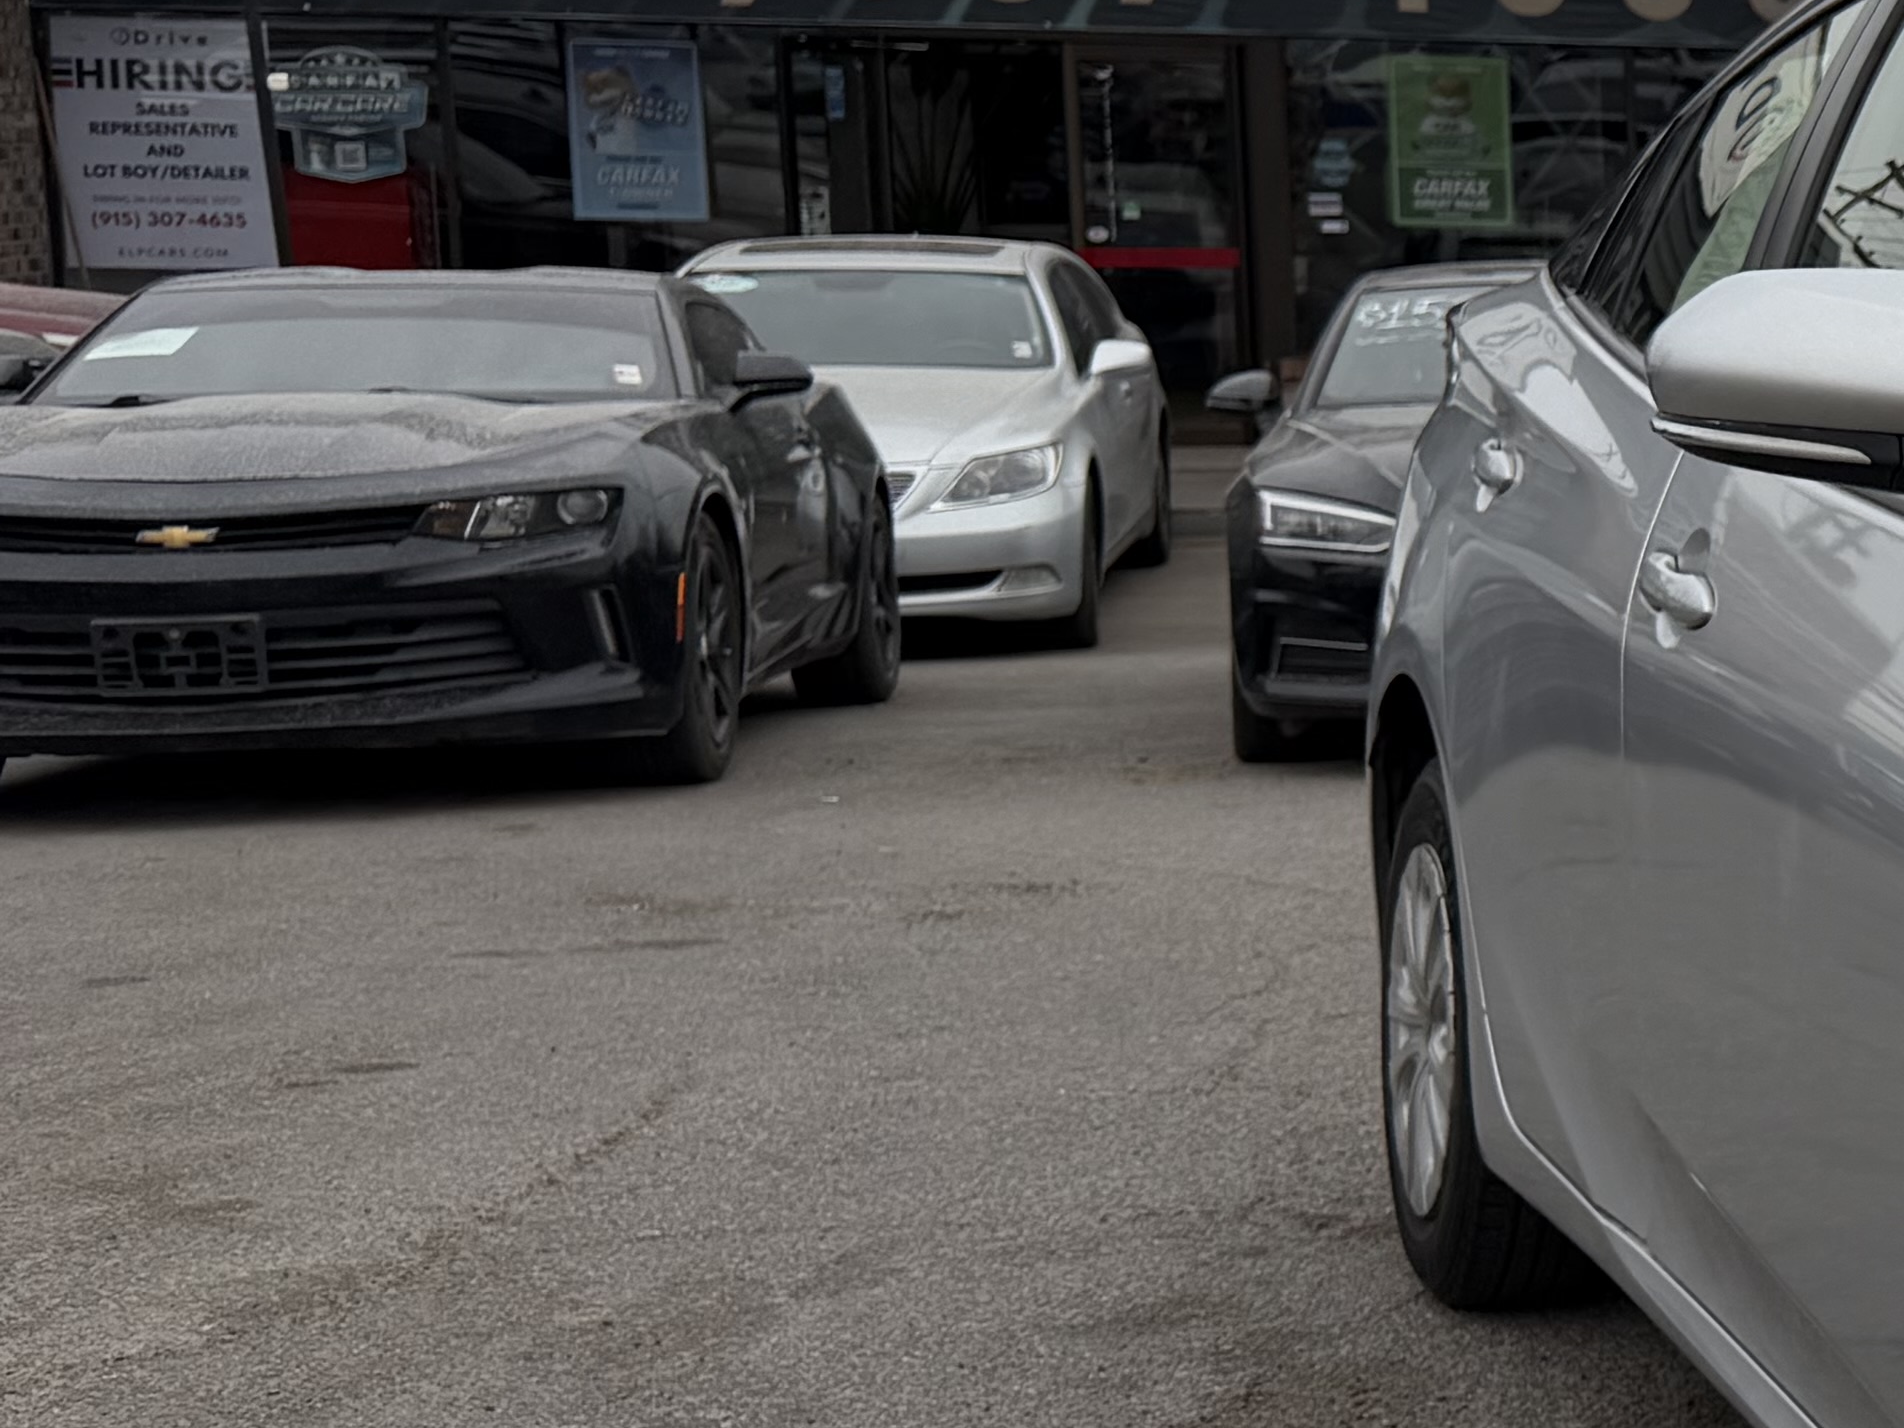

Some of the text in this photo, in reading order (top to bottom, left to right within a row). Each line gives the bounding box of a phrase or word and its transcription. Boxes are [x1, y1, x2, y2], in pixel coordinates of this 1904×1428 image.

[75, 58, 244, 92] HIRING
[135, 102, 190, 116] SALES
[89, 121, 239, 139] REPRESENTATIVE
[146, 143, 185, 158] AND
[83, 164, 251, 181] LOT BOY/DETAILER
[1413, 178, 1491, 197] CARFAX
[91, 211, 248, 230] (915) 307-4635
